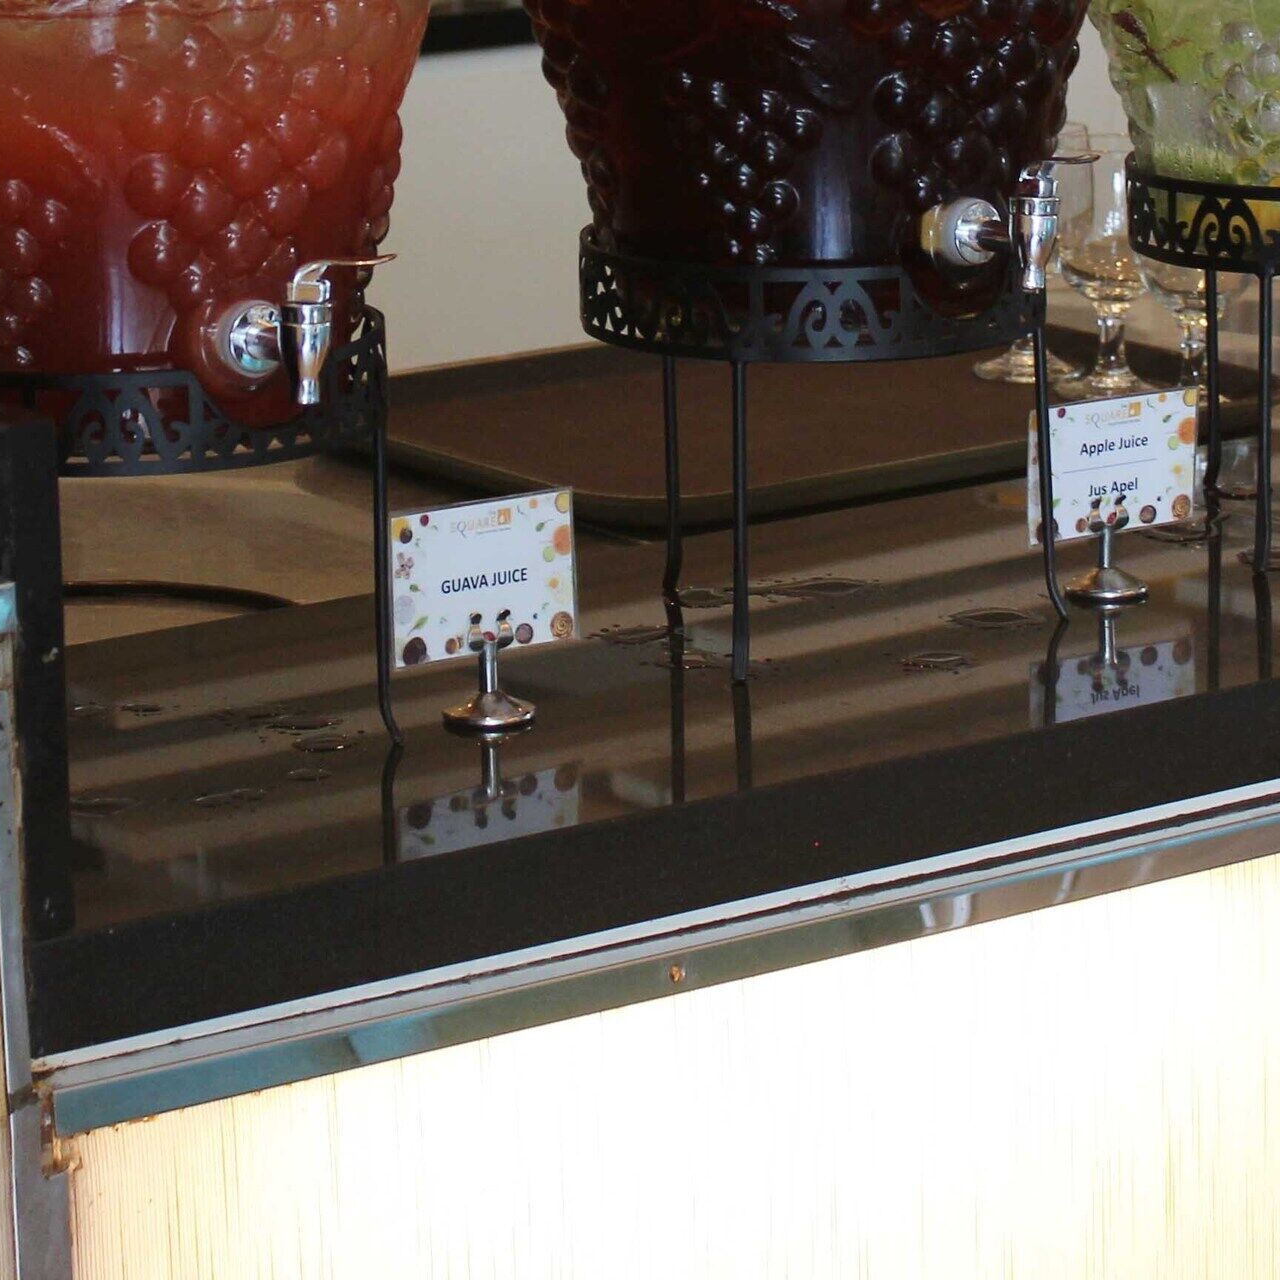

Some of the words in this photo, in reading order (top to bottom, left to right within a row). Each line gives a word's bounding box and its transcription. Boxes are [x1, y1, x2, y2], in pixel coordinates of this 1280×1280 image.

[1080, 438, 1115, 457] Apple
[1118, 434, 1149, 450] Juice
[1088, 484, 1107, 497] Jus
[1111, 477, 1138, 495] Apel
[441, 573, 489, 594] GUAVA
[491, 567, 528, 587] JUICE
